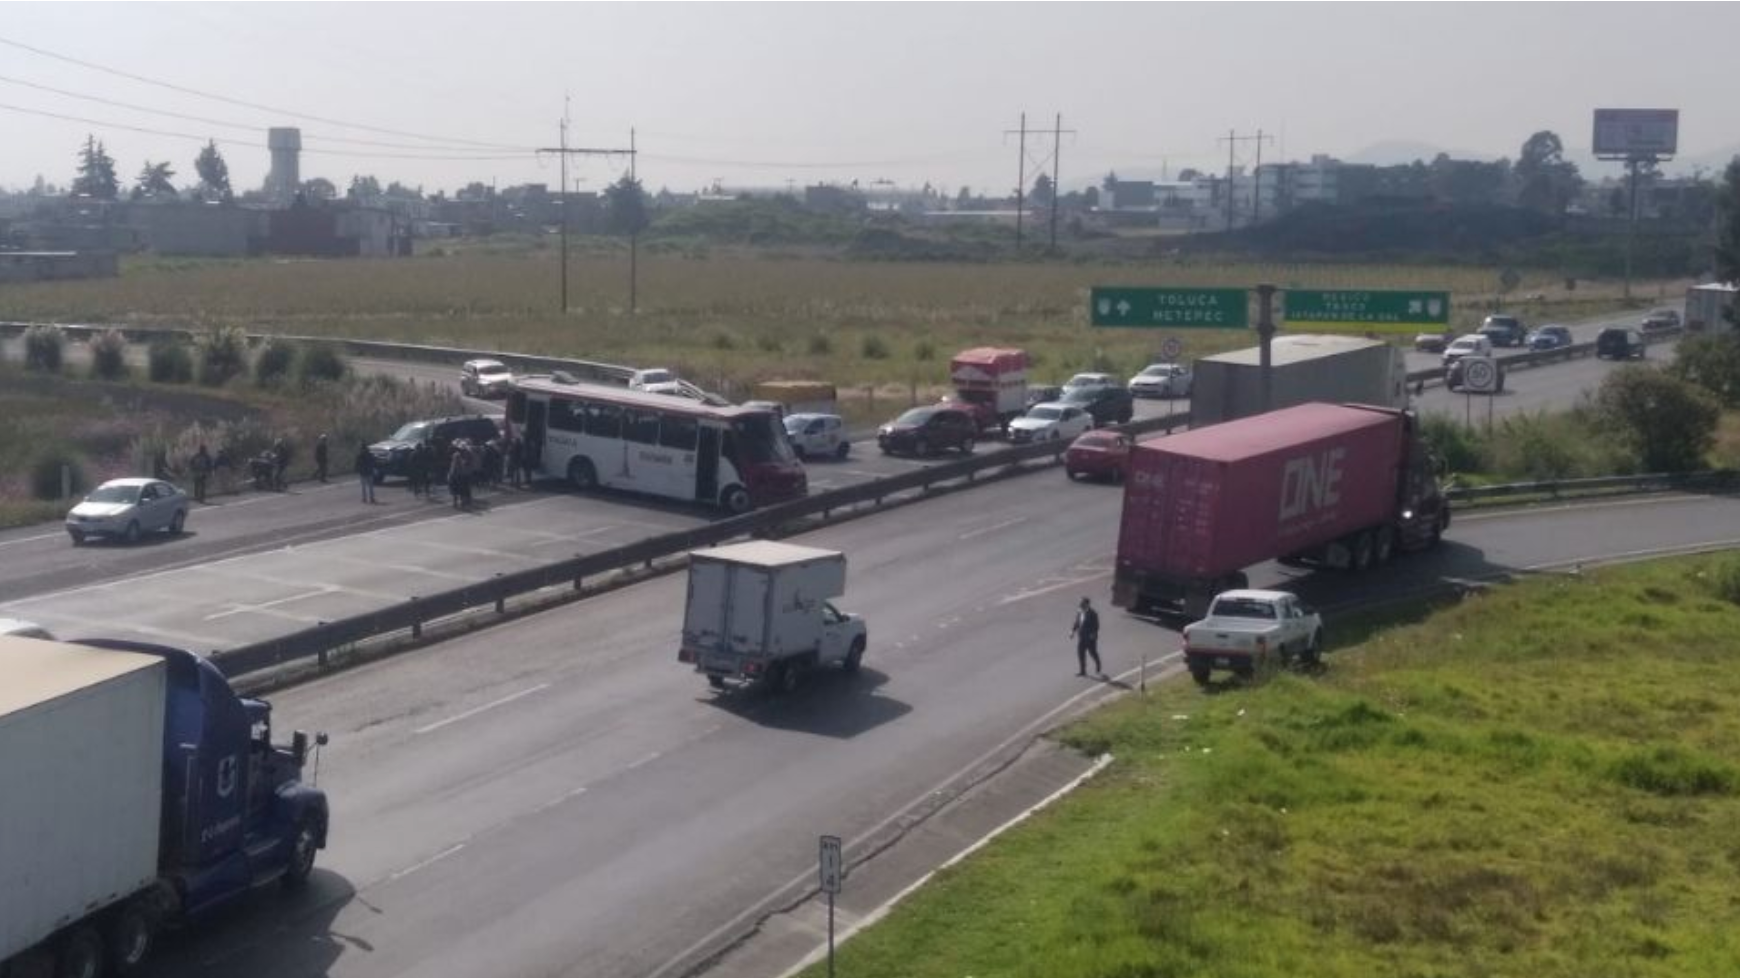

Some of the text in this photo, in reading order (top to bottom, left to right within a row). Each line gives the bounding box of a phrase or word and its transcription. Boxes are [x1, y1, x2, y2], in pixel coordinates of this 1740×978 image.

[1158, 294, 1219, 306] TOLUCA
[1153, 309, 1223, 322] METEPEC
[1279, 446, 1346, 521] ONE
